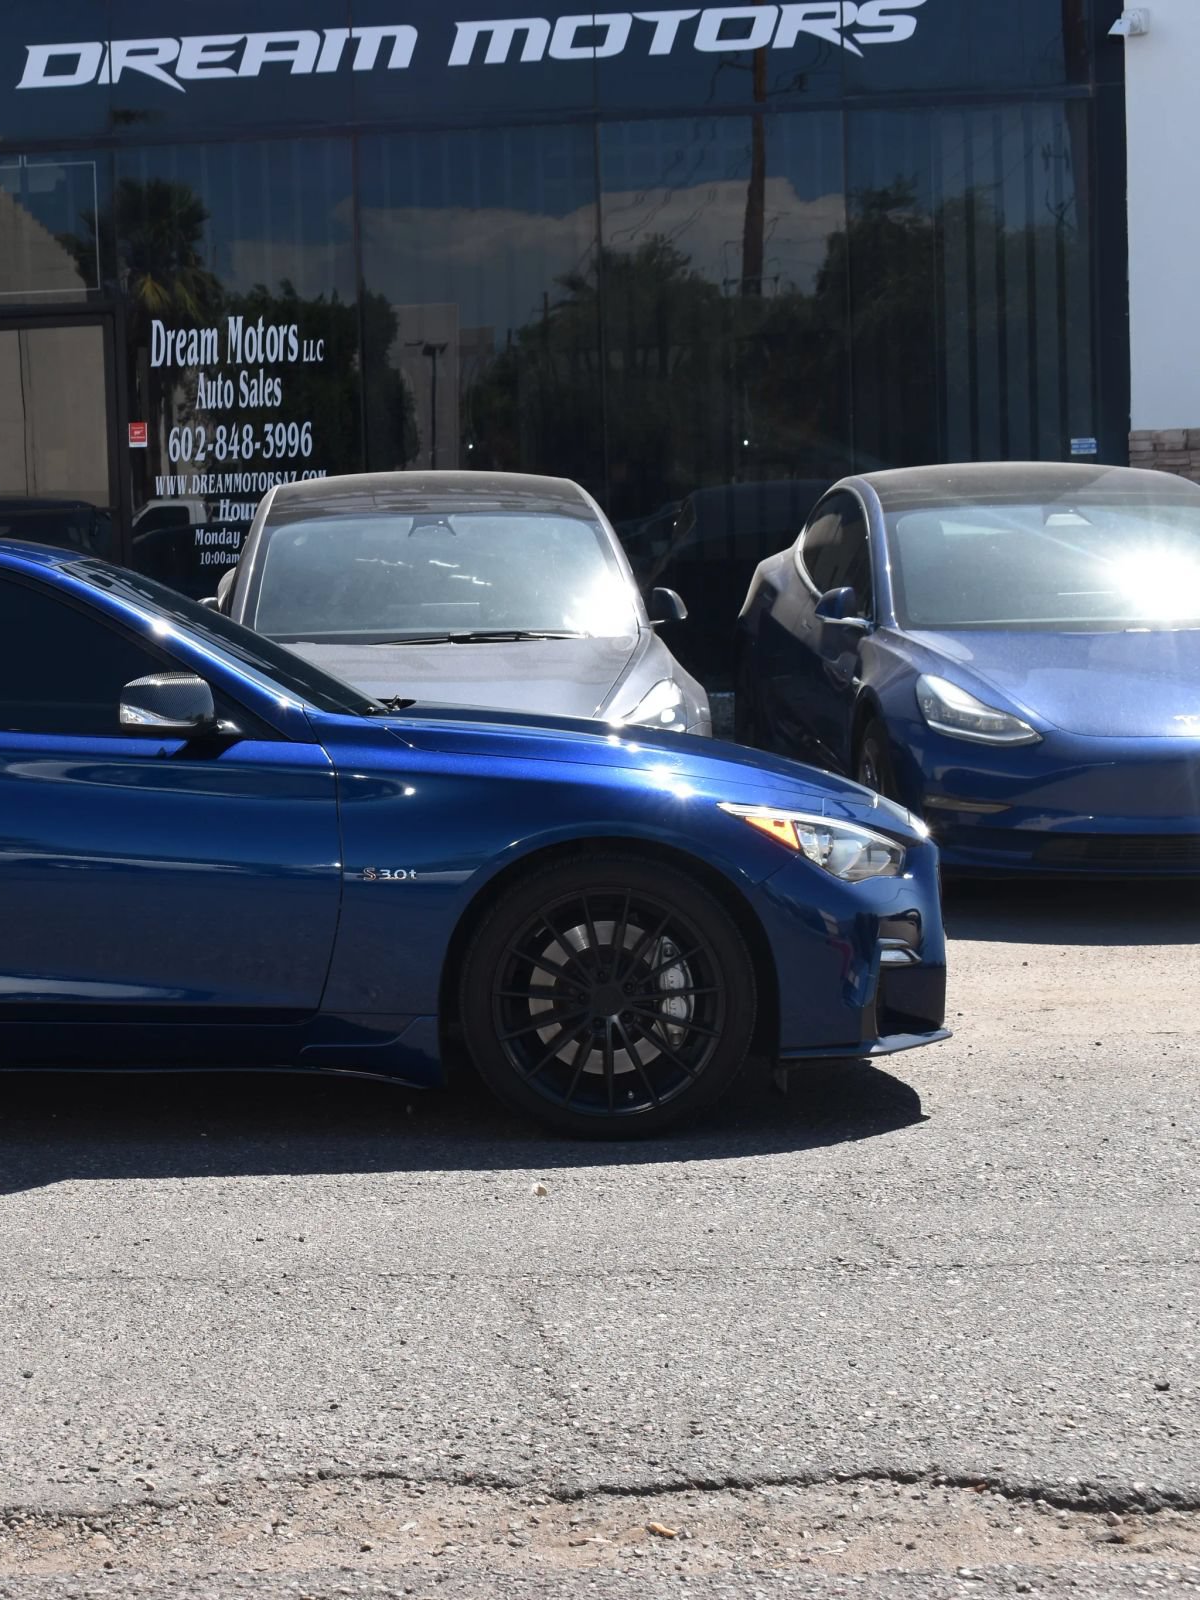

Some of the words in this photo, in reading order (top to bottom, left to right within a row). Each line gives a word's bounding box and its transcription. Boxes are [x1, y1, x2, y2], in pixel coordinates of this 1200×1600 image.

[15, 23, 418, 93] DREAM
[447, 0, 928, 66] MOTORS
[151, 319, 218, 367] Dream
[227, 315, 298, 364] Motors
[303, 339, 324, 362] LLC
[195, 372, 234, 410] Auto
[239, 368, 282, 408] Sales
[169, 421, 313, 462] 602-848-3996
[195, 528, 241, 549] Monday
